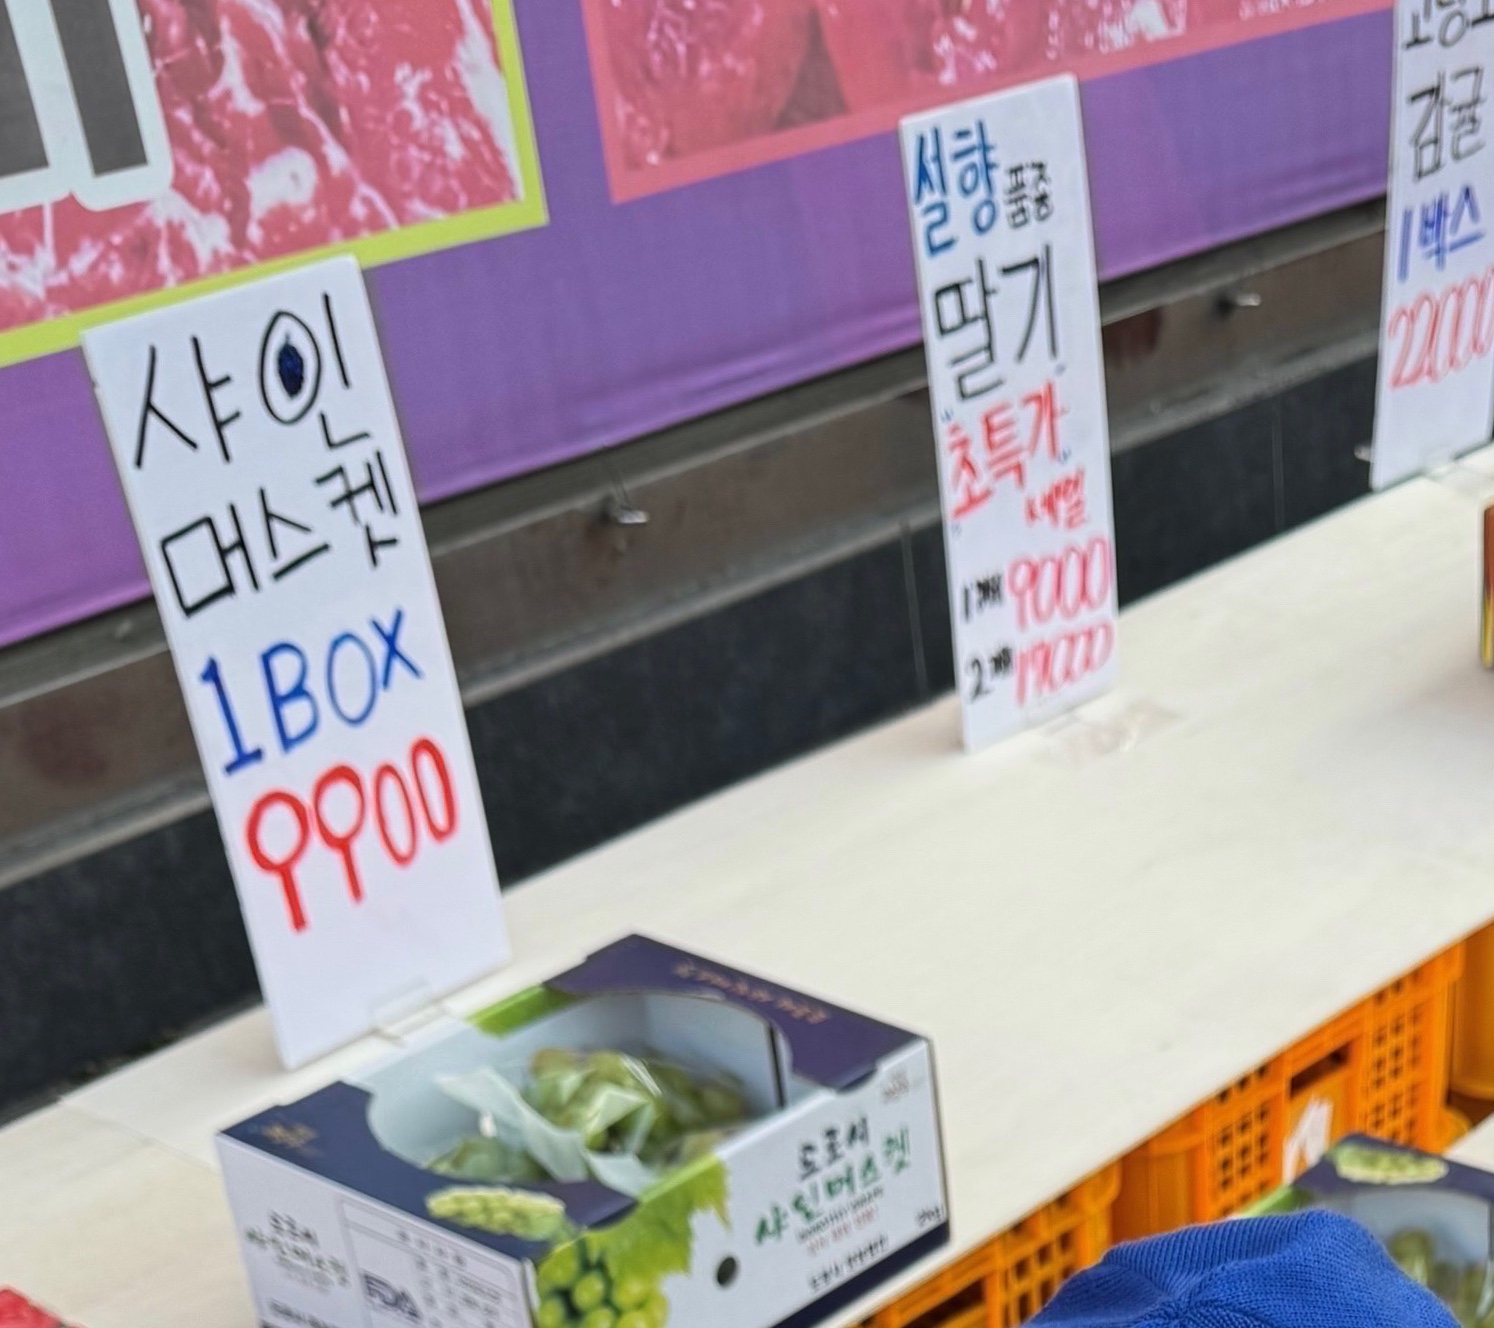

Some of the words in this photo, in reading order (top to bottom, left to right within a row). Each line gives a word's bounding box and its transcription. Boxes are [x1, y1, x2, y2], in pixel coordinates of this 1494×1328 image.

[914, 119, 1000, 257] 설향
[1406, 67, 1488, 181] 감귤
[134, 291, 373, 470] 샤인
[934, 243, 1059, 400] 딸기
[160, 450, 400, 619] 머스켓
[1007, 536, 1113, 630] 9000
[246, 737, 458, 933] 9900
